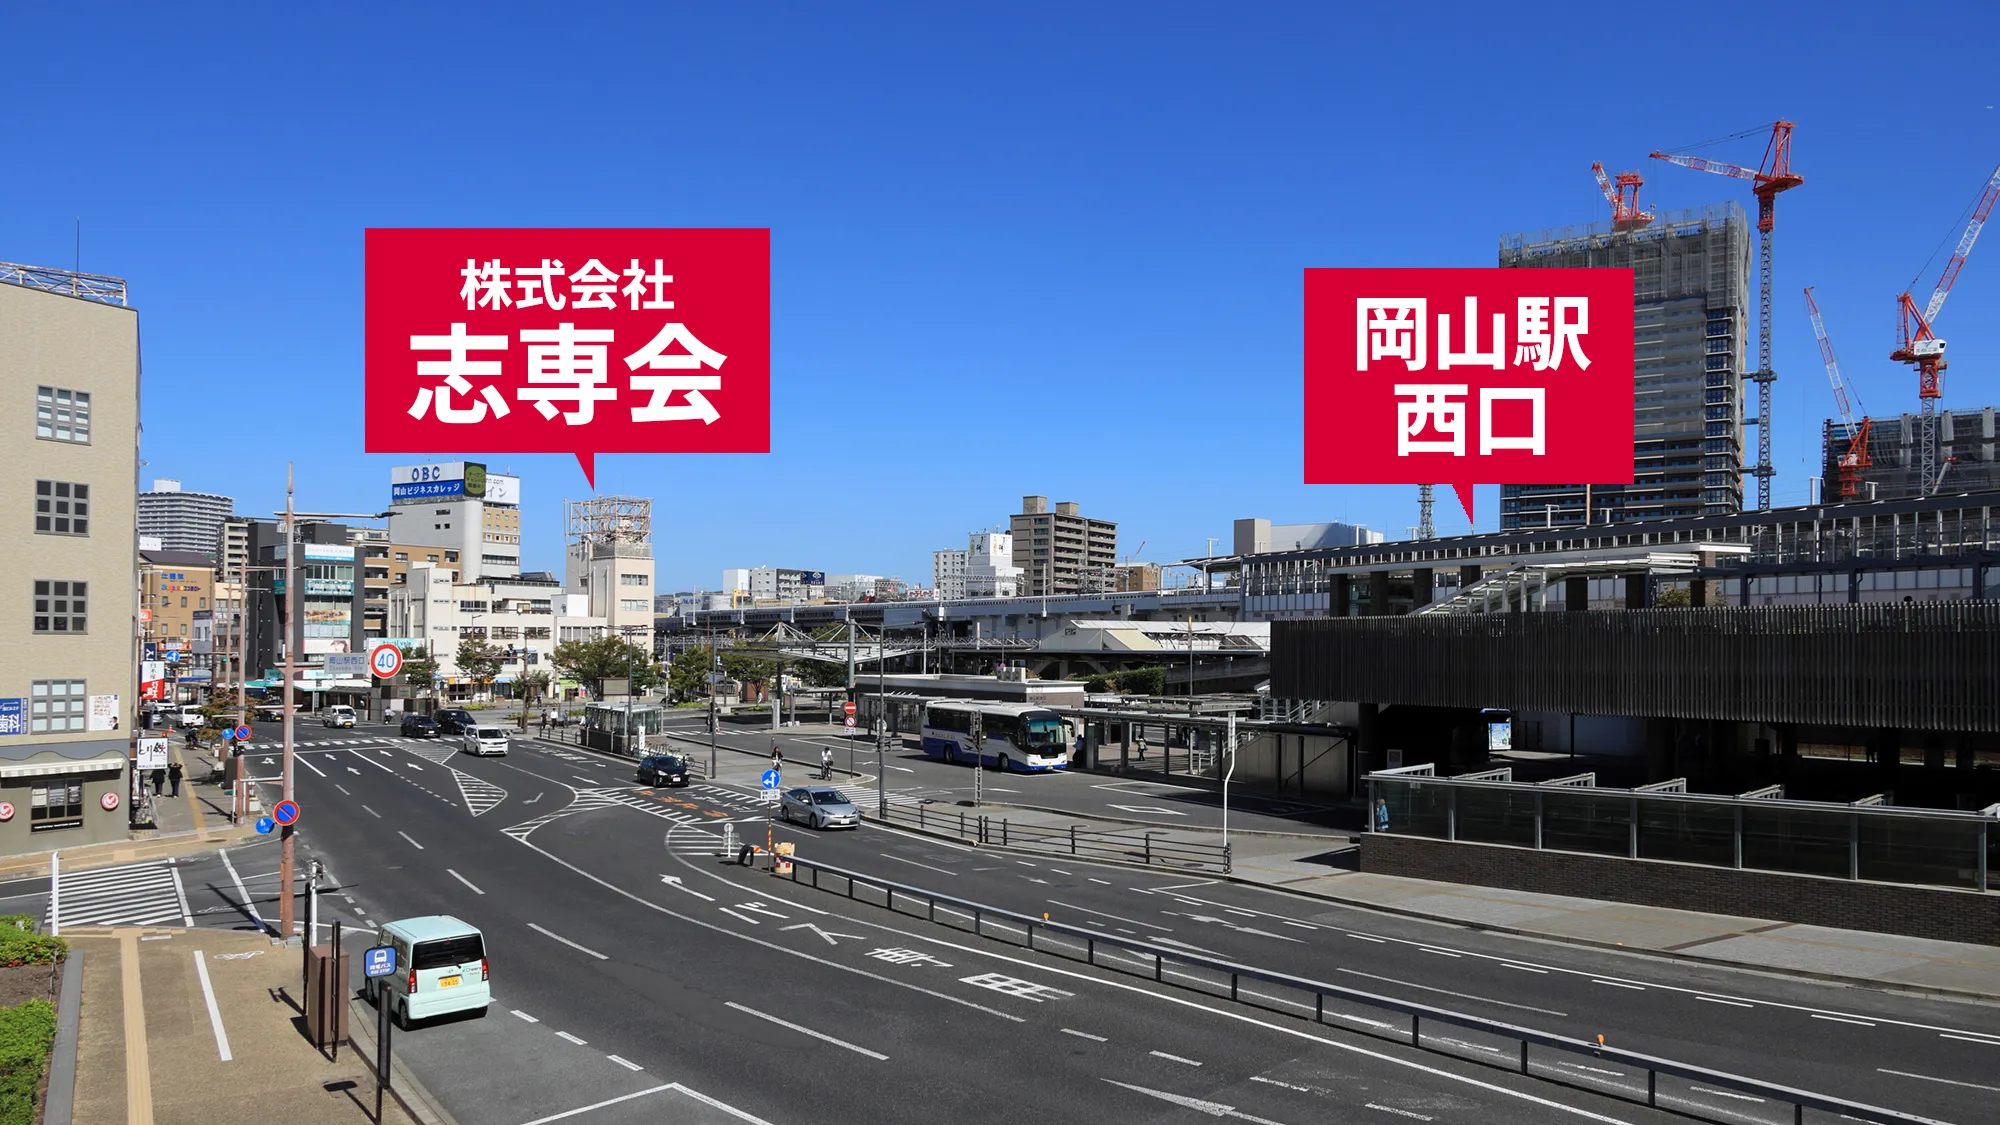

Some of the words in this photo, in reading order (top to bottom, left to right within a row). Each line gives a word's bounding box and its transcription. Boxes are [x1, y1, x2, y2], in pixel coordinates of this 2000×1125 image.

[411, 466, 441, 481] OBC
[393, 482, 460, 496] 岡山ビジネスカレッジ
[329, 656, 364, 665] 岡山駅西口
[377, 653, 395, 668] 40
